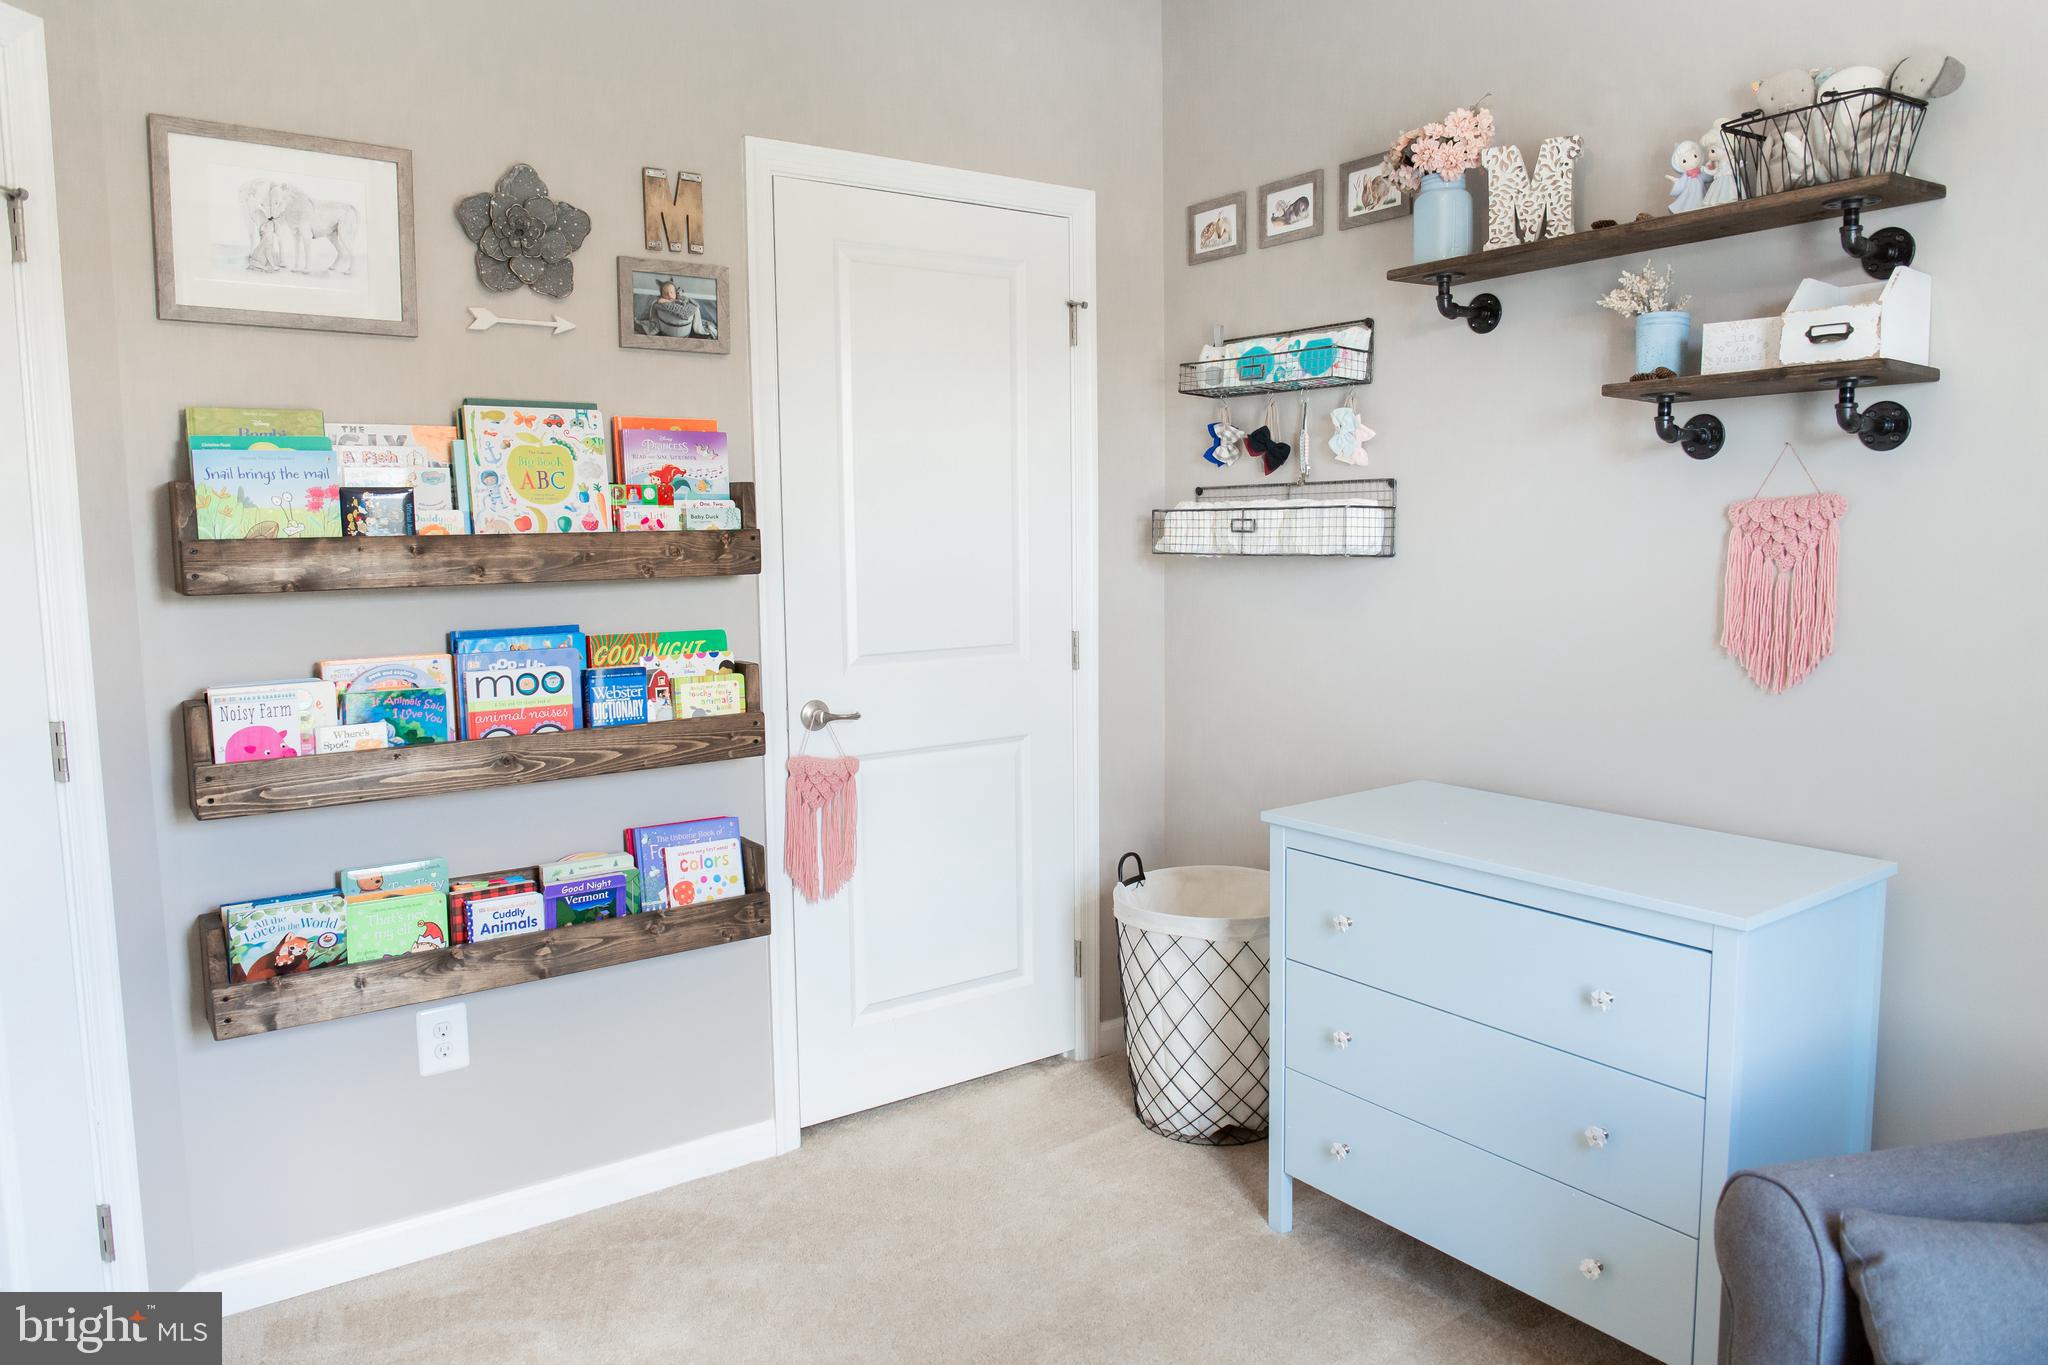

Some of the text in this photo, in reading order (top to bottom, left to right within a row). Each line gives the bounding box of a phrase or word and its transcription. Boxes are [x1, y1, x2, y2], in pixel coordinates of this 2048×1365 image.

[1481, 134, 1585, 252] M
[642, 166, 704, 254] M
[341, 425, 366, 434] THE
[203, 465, 330, 486] Snail brings the mail
[520, 469, 566, 490] ABC
[593, 639, 706, 666] GOODNIGHT
[475, 671, 565, 698] moo
[591, 685, 644, 700] Webster
[371, 695, 445, 712] If Animals Said
[592, 699, 644, 720] DICTIONARY
[219, 703, 292, 725] Noisy Farm
[392, 708, 444, 724] I Love You
[475, 707, 568, 724] animal noises
[333, 728, 370, 739] Where's
[323, 740, 349, 751] Spot?
[656, 834, 669, 843] The
[670, 831, 697, 842] Usborne
[698, 830, 716, 839] Book
[679, 854, 729, 873] colors
[561, 879, 612, 894] Good Night
[565, 891, 609, 905] Vermont
[253, 916, 288, 929] All the
[492, 908, 526, 920] Cuddly
[243, 917, 338, 943] Love in the World
[480, 915, 538, 935] Animals
